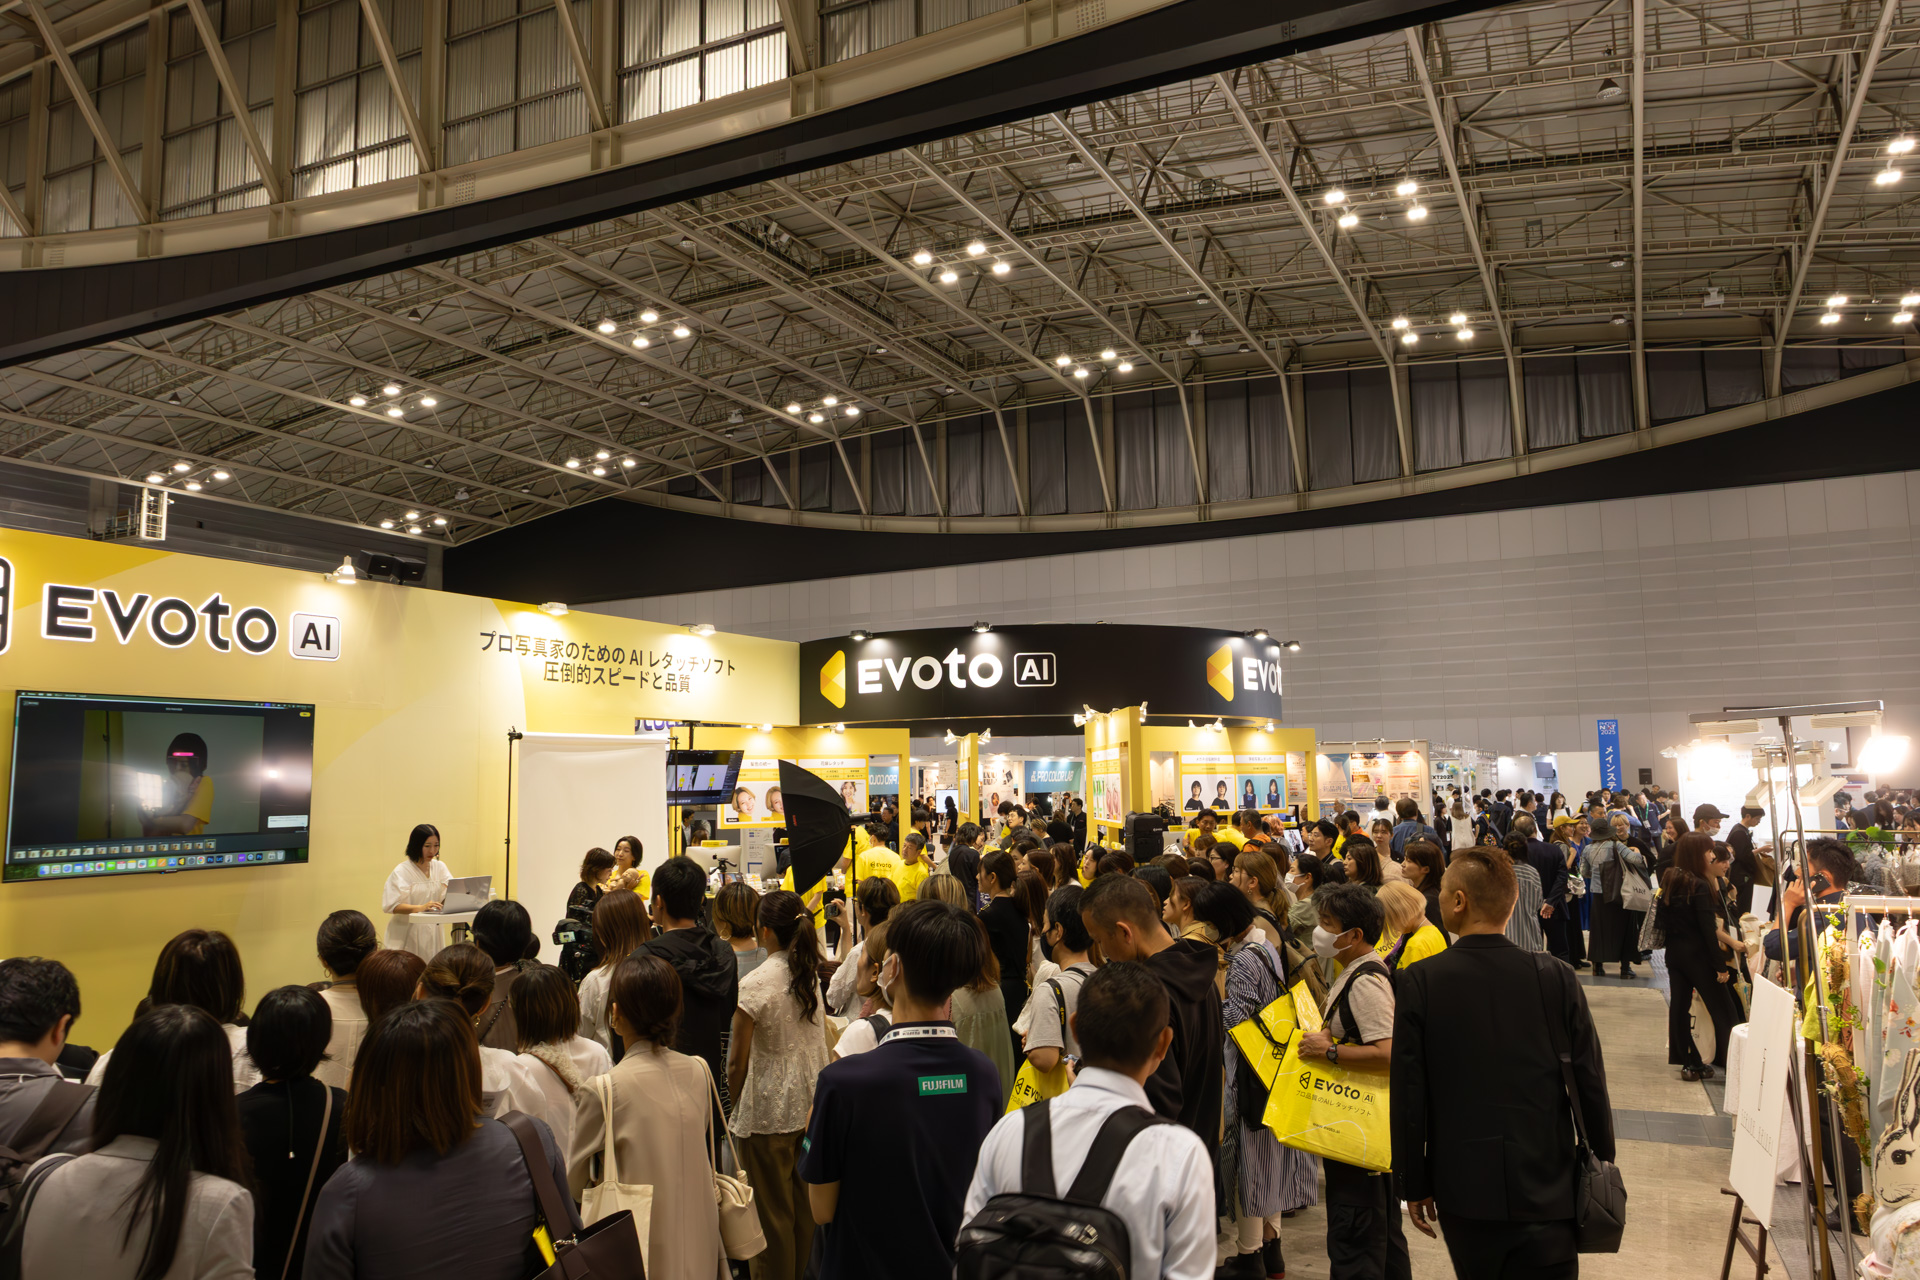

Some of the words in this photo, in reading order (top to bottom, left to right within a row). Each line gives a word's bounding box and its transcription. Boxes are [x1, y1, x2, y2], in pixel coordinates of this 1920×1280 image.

[299, 622, 331, 652] AI
[480, 630, 625, 665] プロ写真家のための
[629, 648, 643, 666] AI
[648, 649, 736, 676] レタッチソフト
[543, 660, 692, 694] 圧倒的スピードと品質
[1020, 658, 1049, 681] AI
[1605, 745, 1617, 793] メインステ
[1296, 1090, 1371, 1117] プロ品質のAIレタッチソフト
[1364, 1094, 1374, 1103] AI
